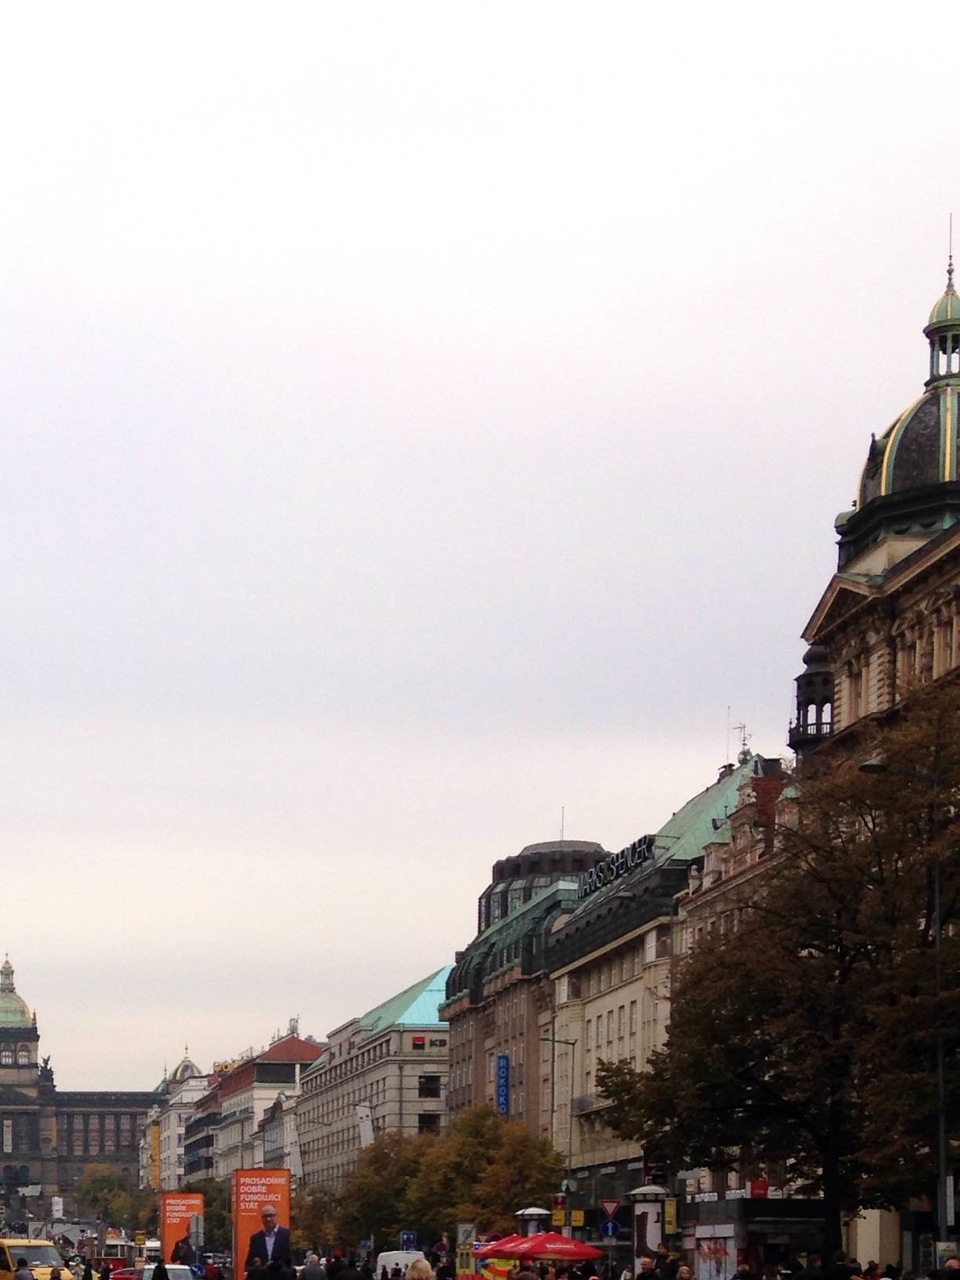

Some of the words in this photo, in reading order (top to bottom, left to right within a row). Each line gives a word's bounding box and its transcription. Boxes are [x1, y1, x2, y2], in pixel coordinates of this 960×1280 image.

[499, 1059, 508, 1114] ROKOKO
[240, 1185, 267, 1193] DOBŘE
[240, 1193, 281, 1202] FUNGUJÍCÍ
